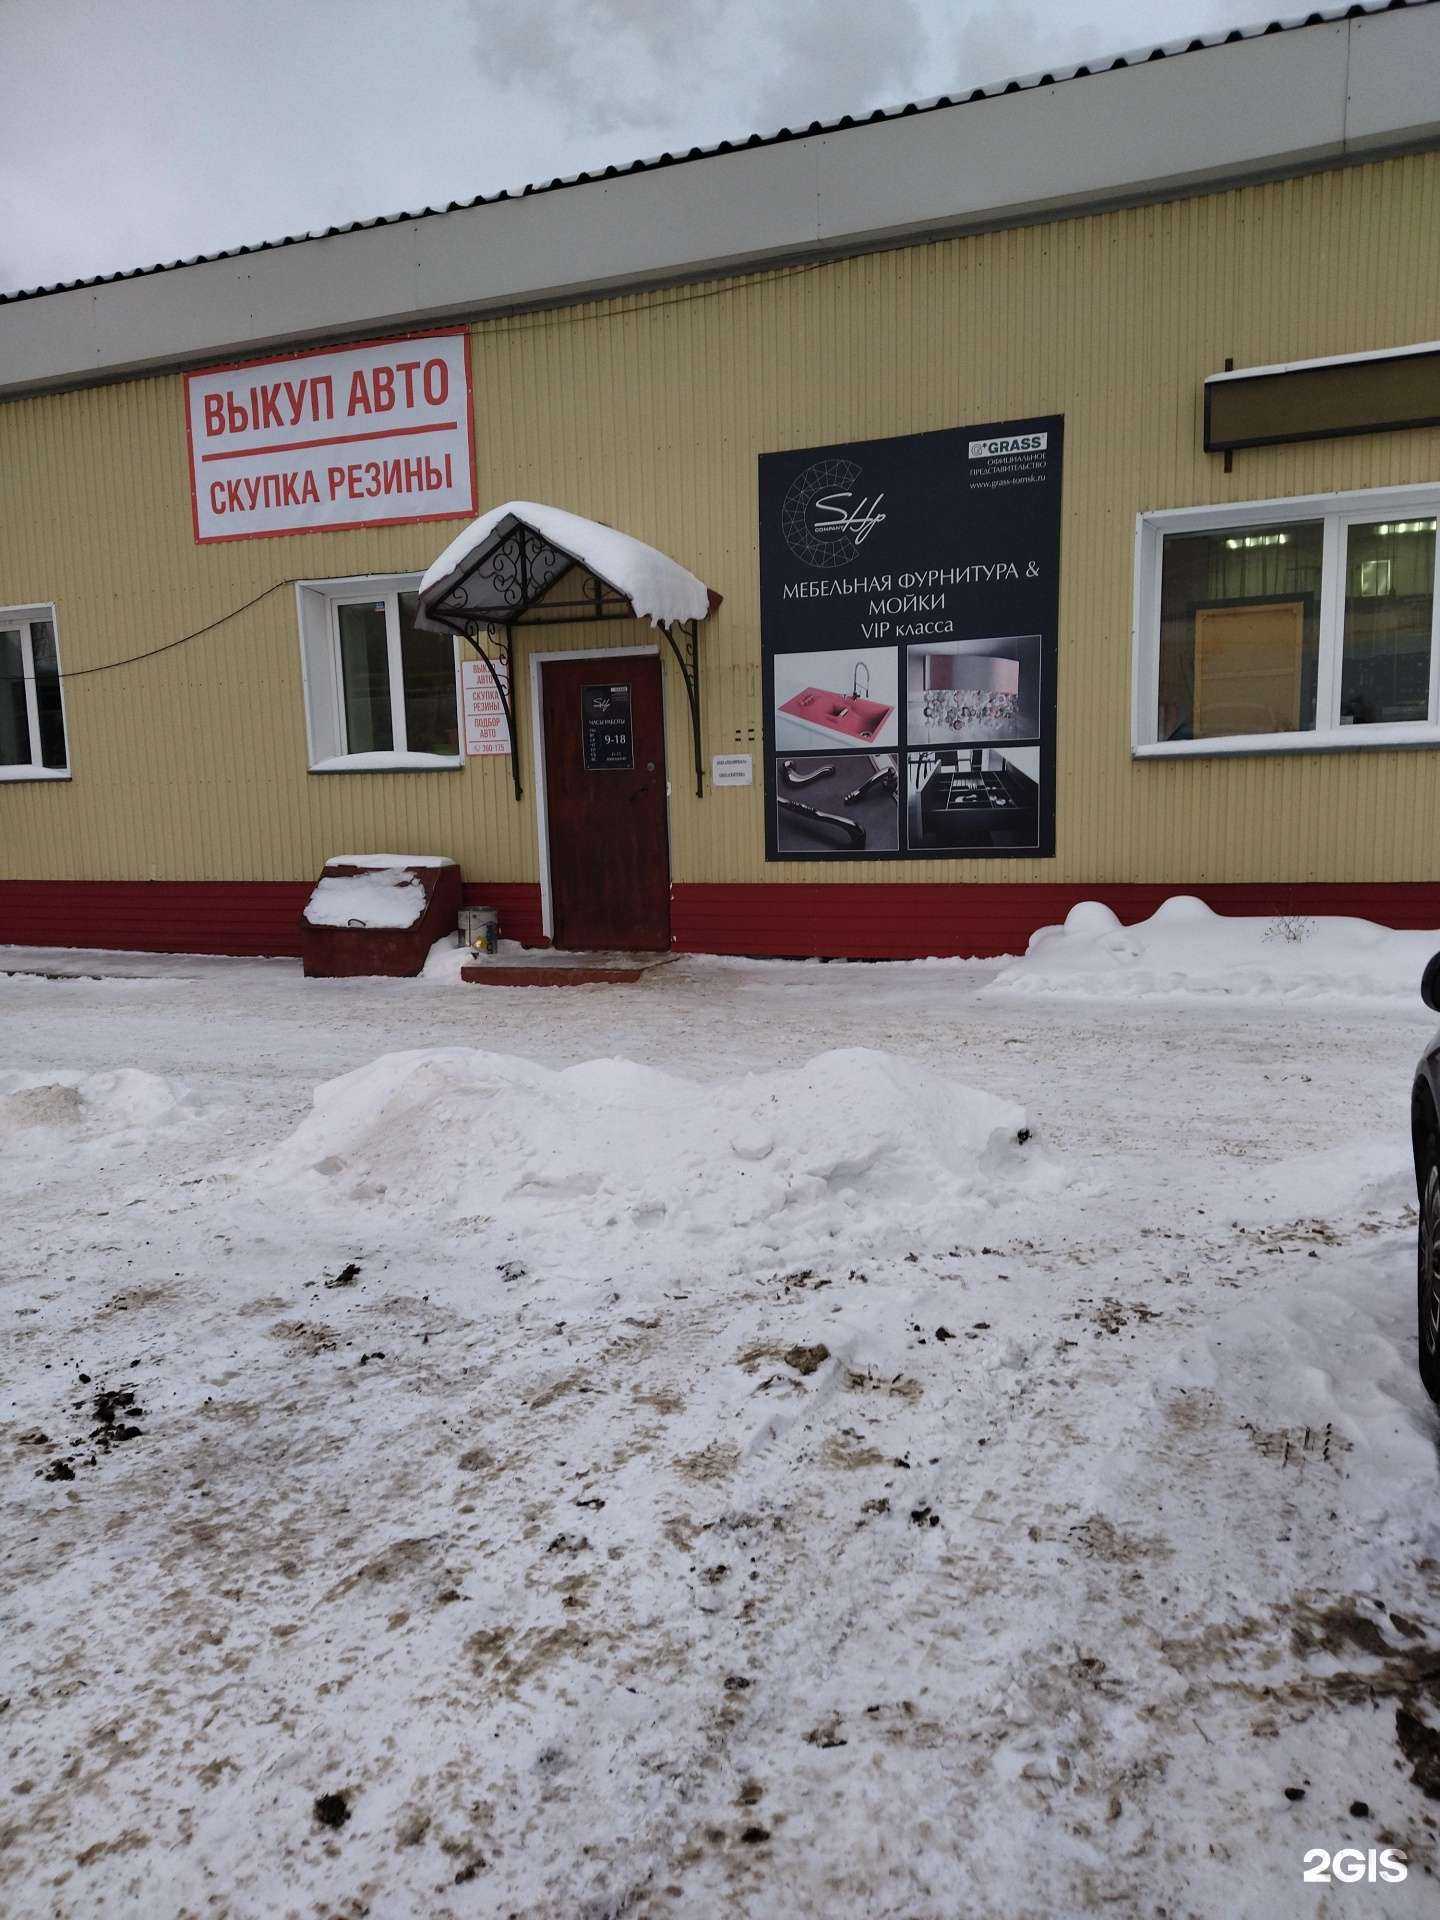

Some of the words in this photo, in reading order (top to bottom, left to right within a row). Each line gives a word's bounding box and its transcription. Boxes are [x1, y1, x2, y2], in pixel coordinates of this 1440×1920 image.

[204, 375, 334, 437] ВЫКУП
[347, 358, 449, 417] АВТО
[988, 437, 1041, 453] GRASS
[209, 470, 321, 515] СКУПКА
[327, 453, 453, 502] РЕЗИНЫ
[783, 574, 893, 600] МЕБЕЛЬНАЯ
[899, 563, 1019, 590] ФУРНИТУРА
[1026, 560, 1041, 578] &
[868, 592, 946, 616] МОЙКИ
[861, 622, 890, 640] VIP
[895, 619, 954, 637] класса
[472, 690, 499, 701] СКУПКА
[473, 701, 500, 712] РЕЗИНЫ
[479, 729, 496, 738] АВТО
[604, 734, 626, 745] 9-18
